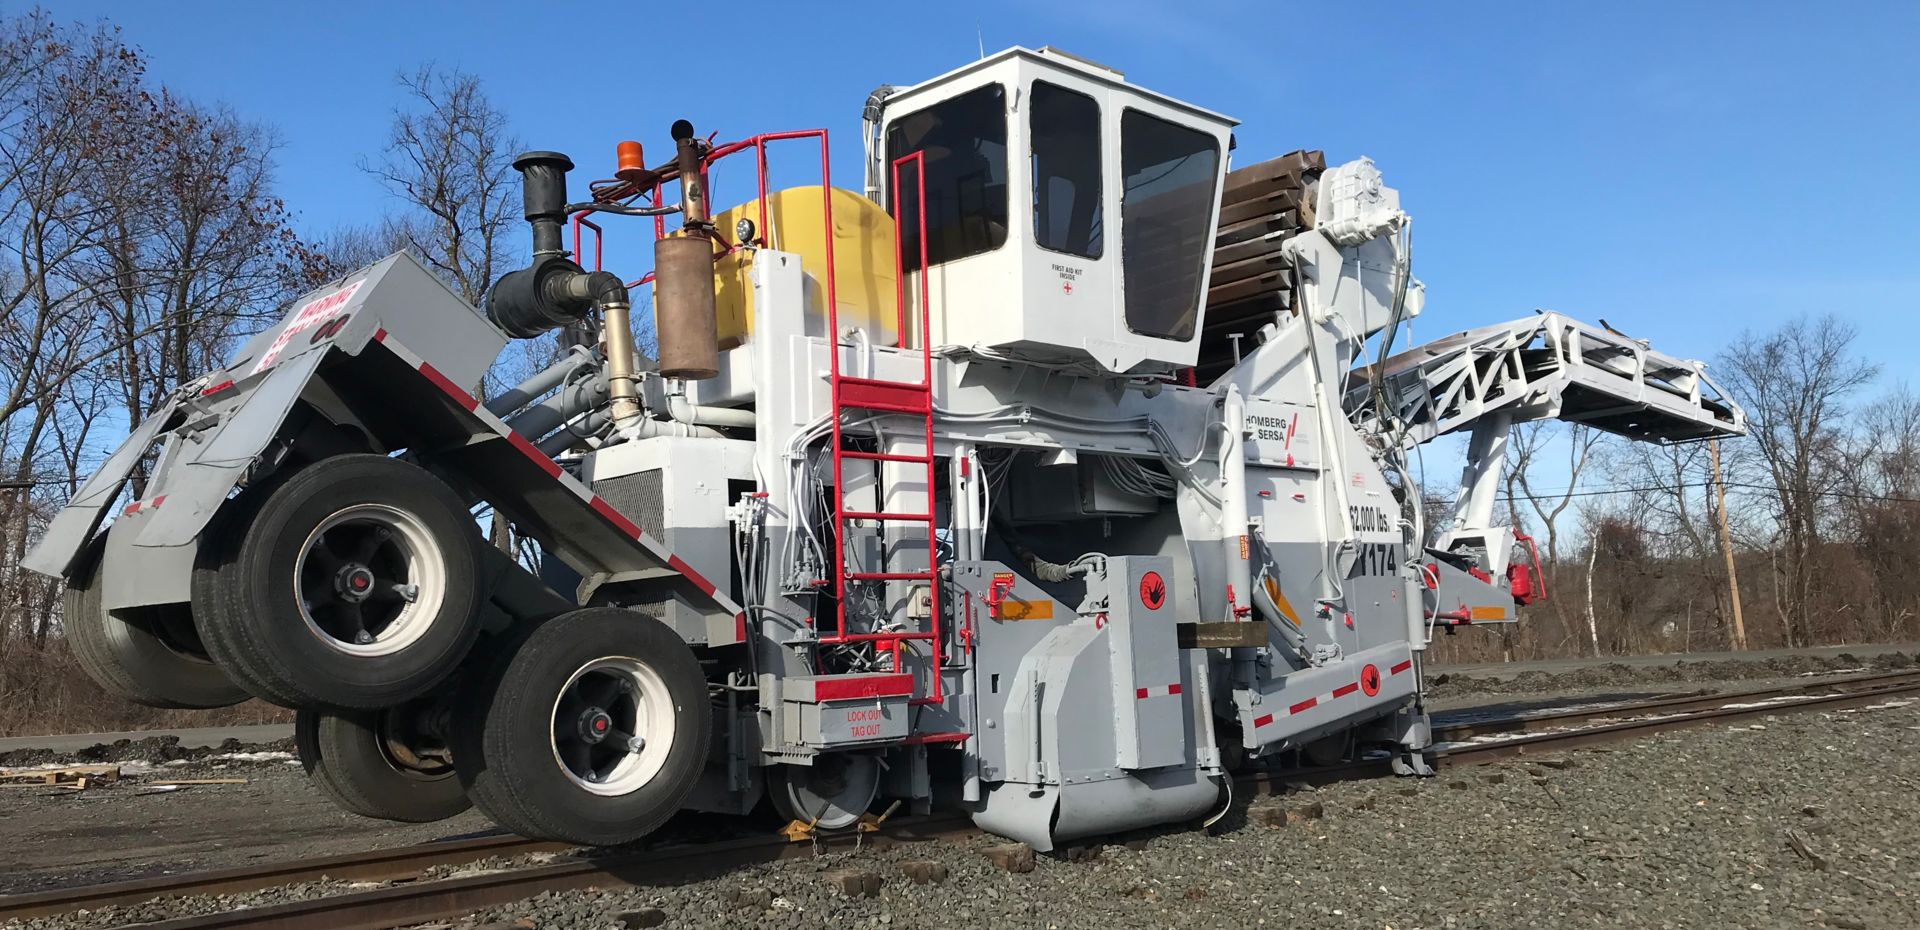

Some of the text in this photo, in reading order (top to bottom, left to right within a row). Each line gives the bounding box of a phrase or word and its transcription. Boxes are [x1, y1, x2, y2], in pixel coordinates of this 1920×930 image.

[1052, 264, 1065, 272] FIRST
[297, 283, 359, 321] WARNING
[1258, 428, 1285, 441] SERSA
[1376, 506, 1391, 533] lbs.
[848, 710, 881, 721] LOCK OUT
[851, 724, 880, 736] TAG OUT
